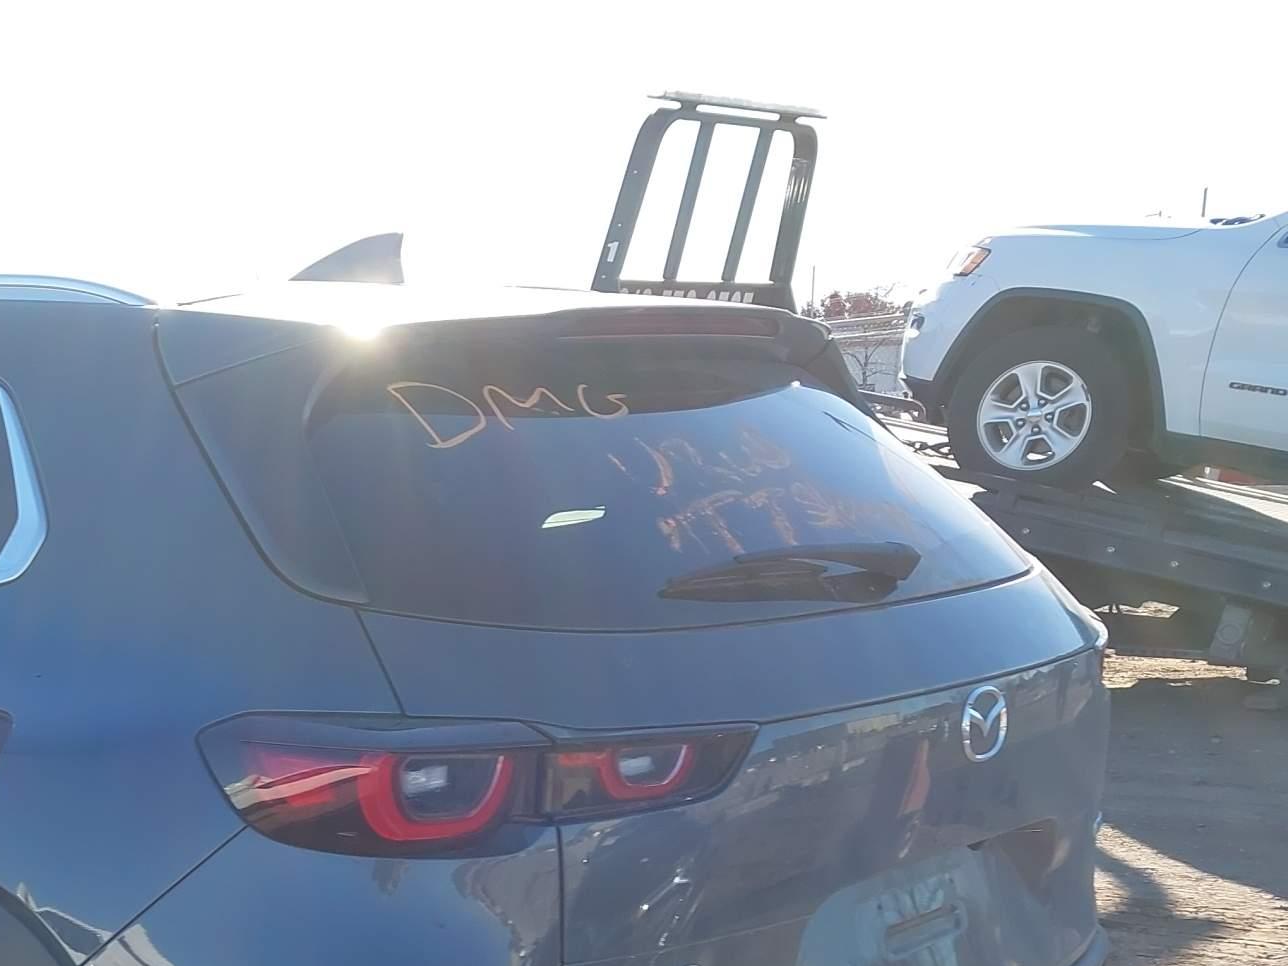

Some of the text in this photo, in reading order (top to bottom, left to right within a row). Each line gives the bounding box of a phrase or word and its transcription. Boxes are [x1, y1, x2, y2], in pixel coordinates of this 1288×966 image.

[606, 241, 619, 262] 1
[1228, 381, 1288, 396] GRAND
[386, 381, 630, 449] DMG
